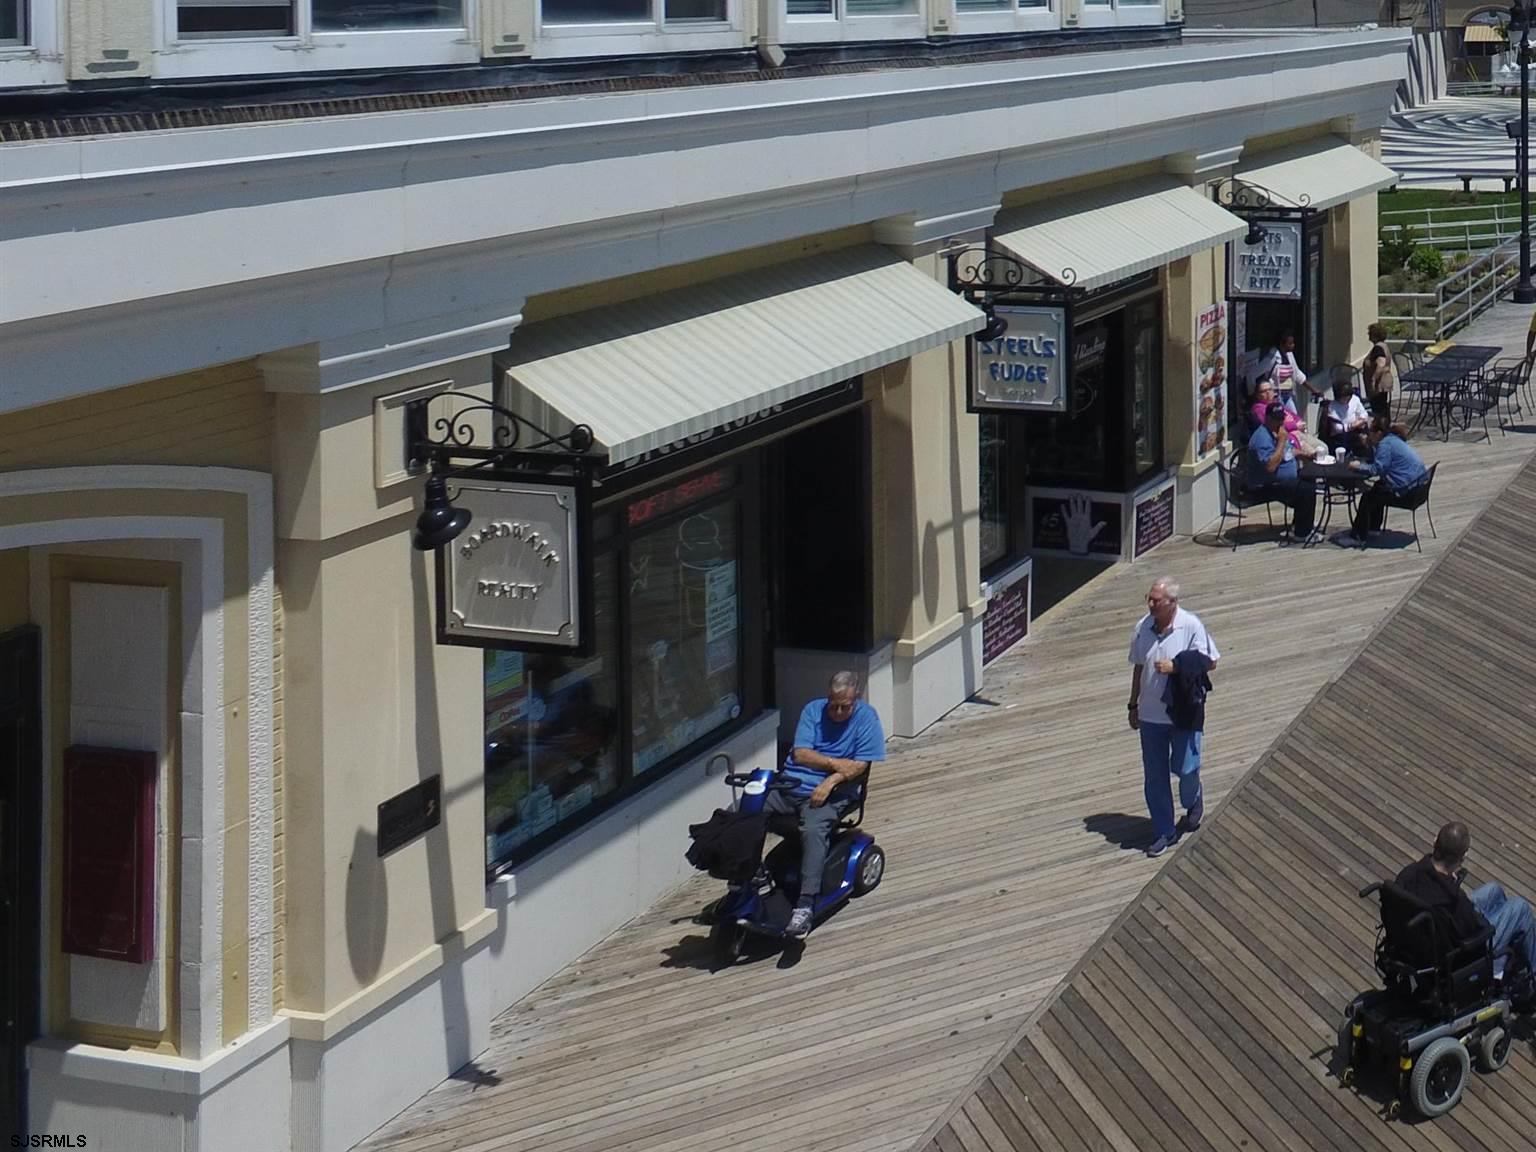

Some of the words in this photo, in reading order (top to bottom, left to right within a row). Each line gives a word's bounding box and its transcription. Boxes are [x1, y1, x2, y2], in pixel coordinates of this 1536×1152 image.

[1240, 253, 1292, 267] TREATS
[1249, 276, 1282, 289] RITZ
[1200, 305, 1225, 328] PIZZA
[982, 334, 1057, 358] STEEL'S
[989, 361, 1049, 384] FUDGE
[460, 521, 560, 567] BOARDWALK
[478, 579, 543, 601] REALTY
